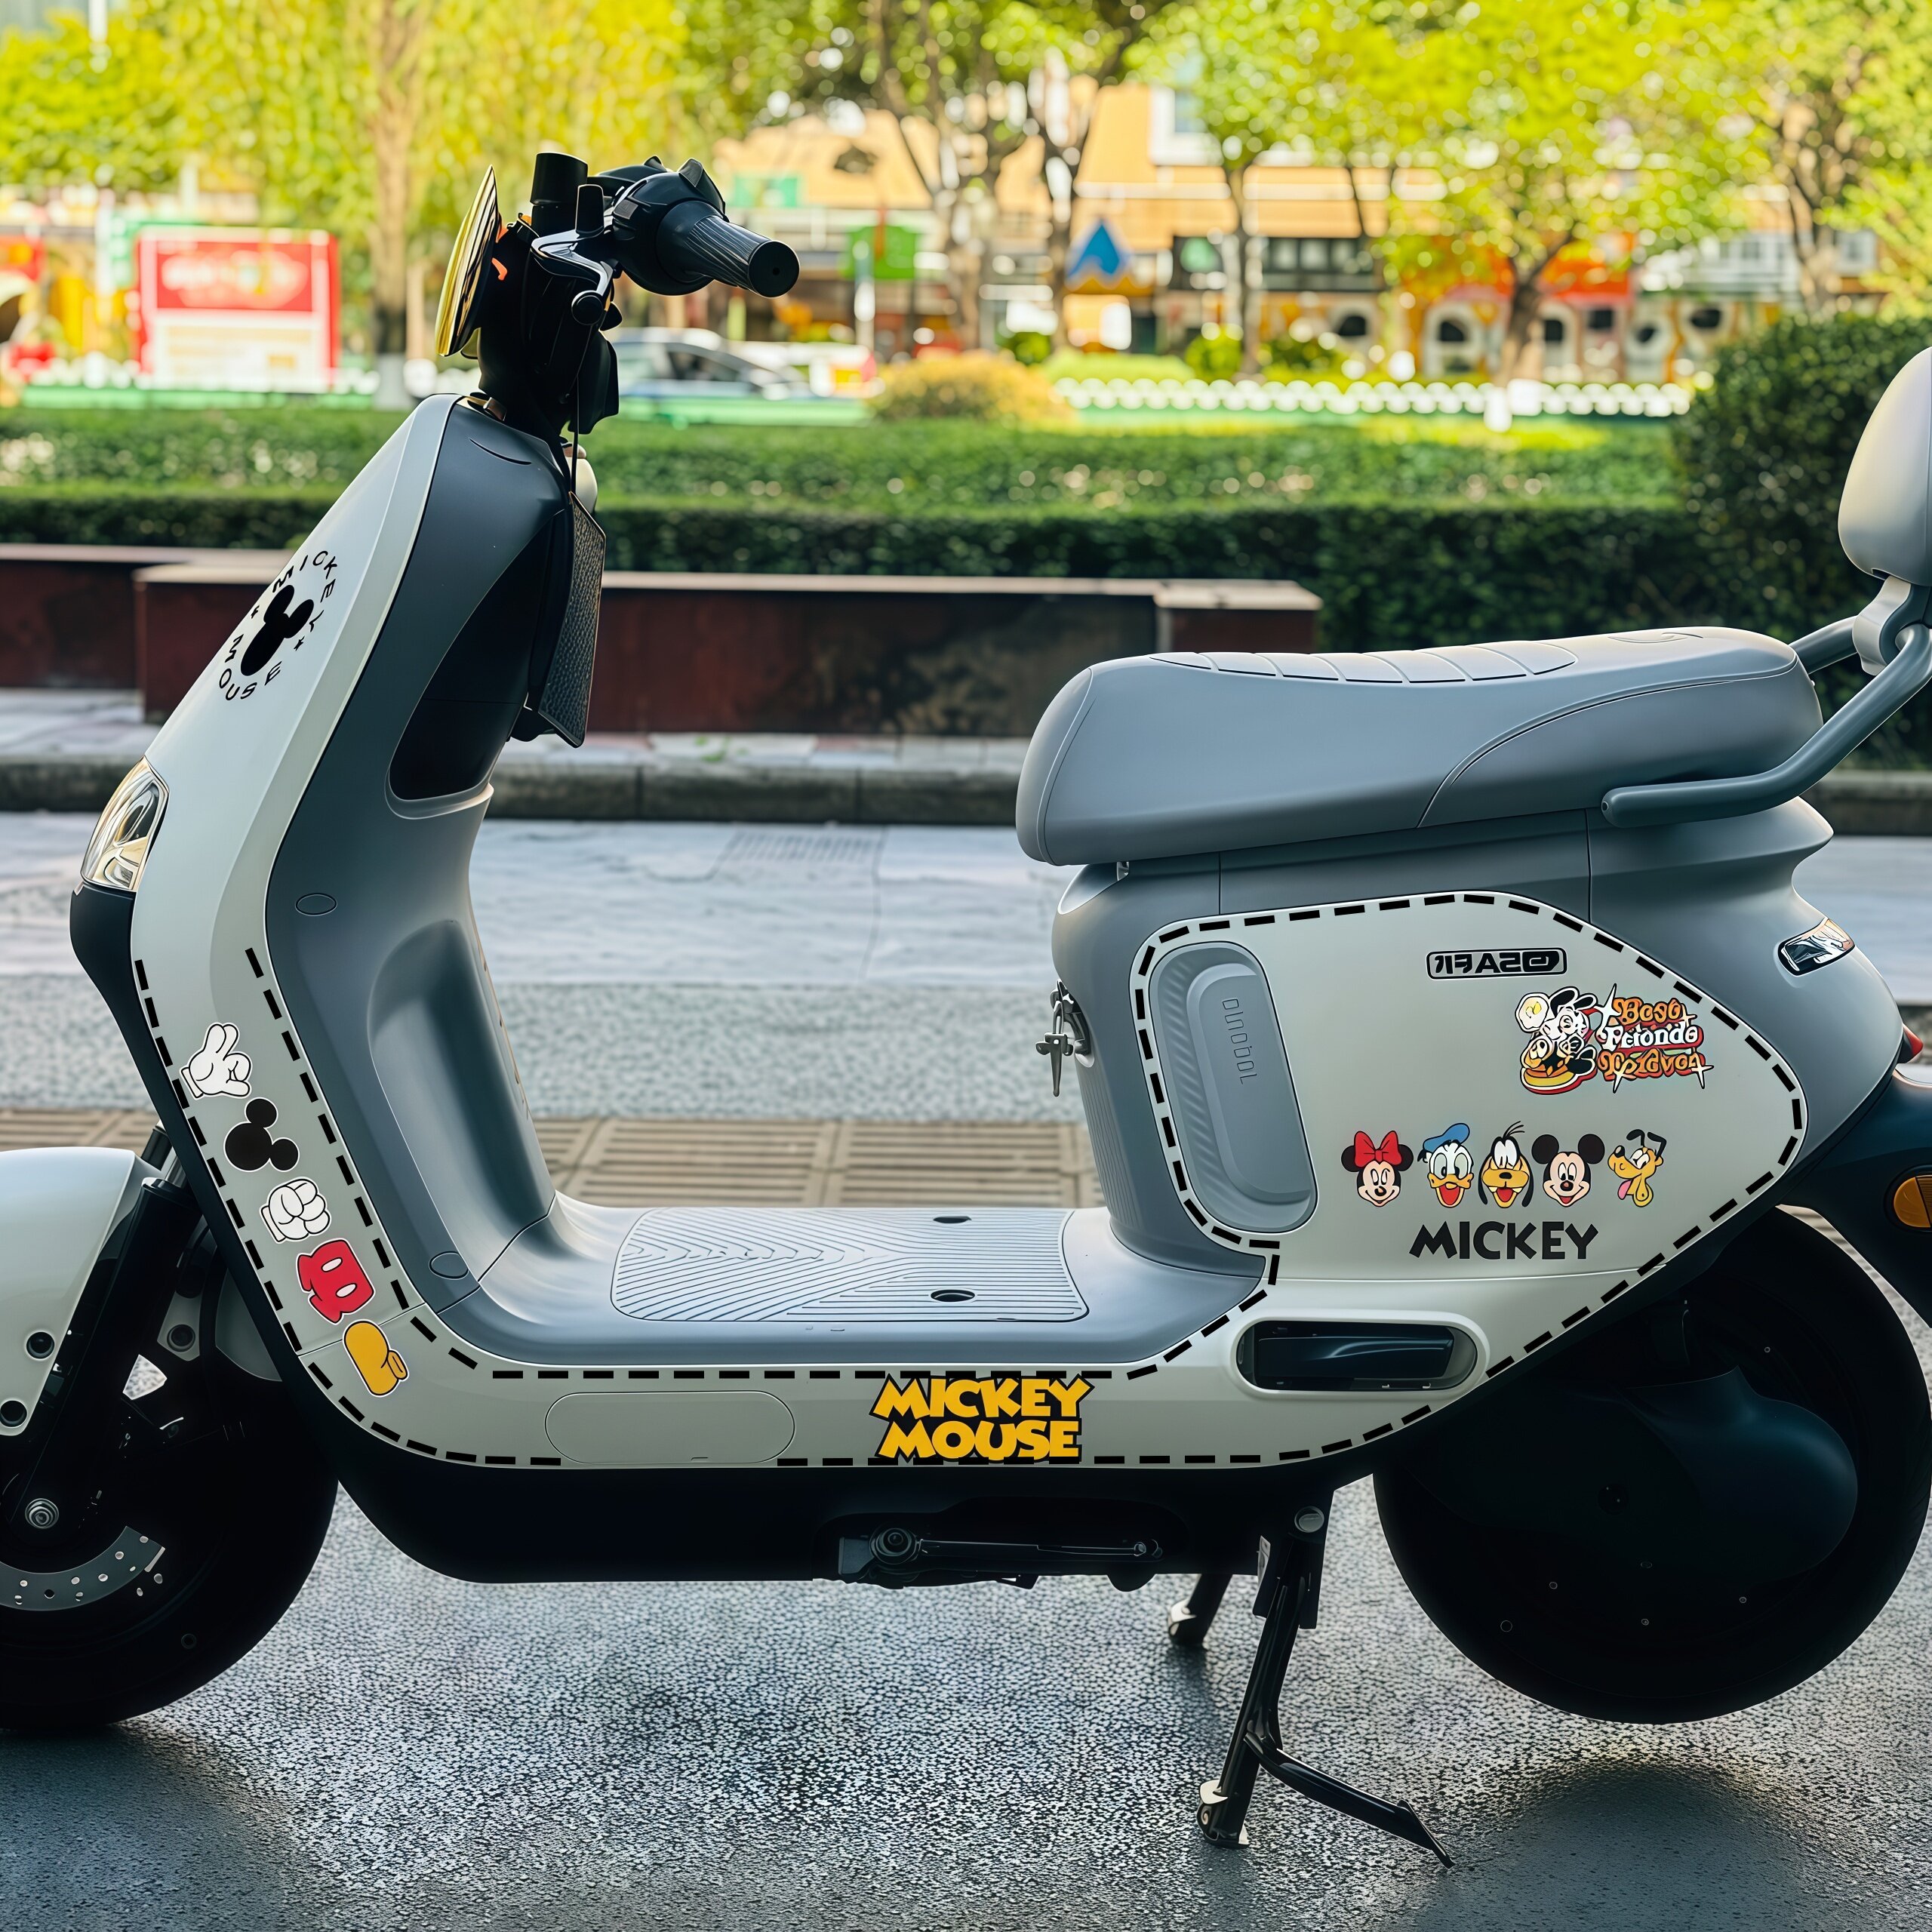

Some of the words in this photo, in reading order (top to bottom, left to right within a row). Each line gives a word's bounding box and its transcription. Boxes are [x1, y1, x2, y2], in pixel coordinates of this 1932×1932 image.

[272, 550, 338, 632] MICKEY
[219, 633, 283, 701] MOUSE
[1409, 1221, 1598, 1260] MICKEY
[869, 1374, 1095, 1421] MICKEY
[875, 1420, 1082, 1462] MOUSE
